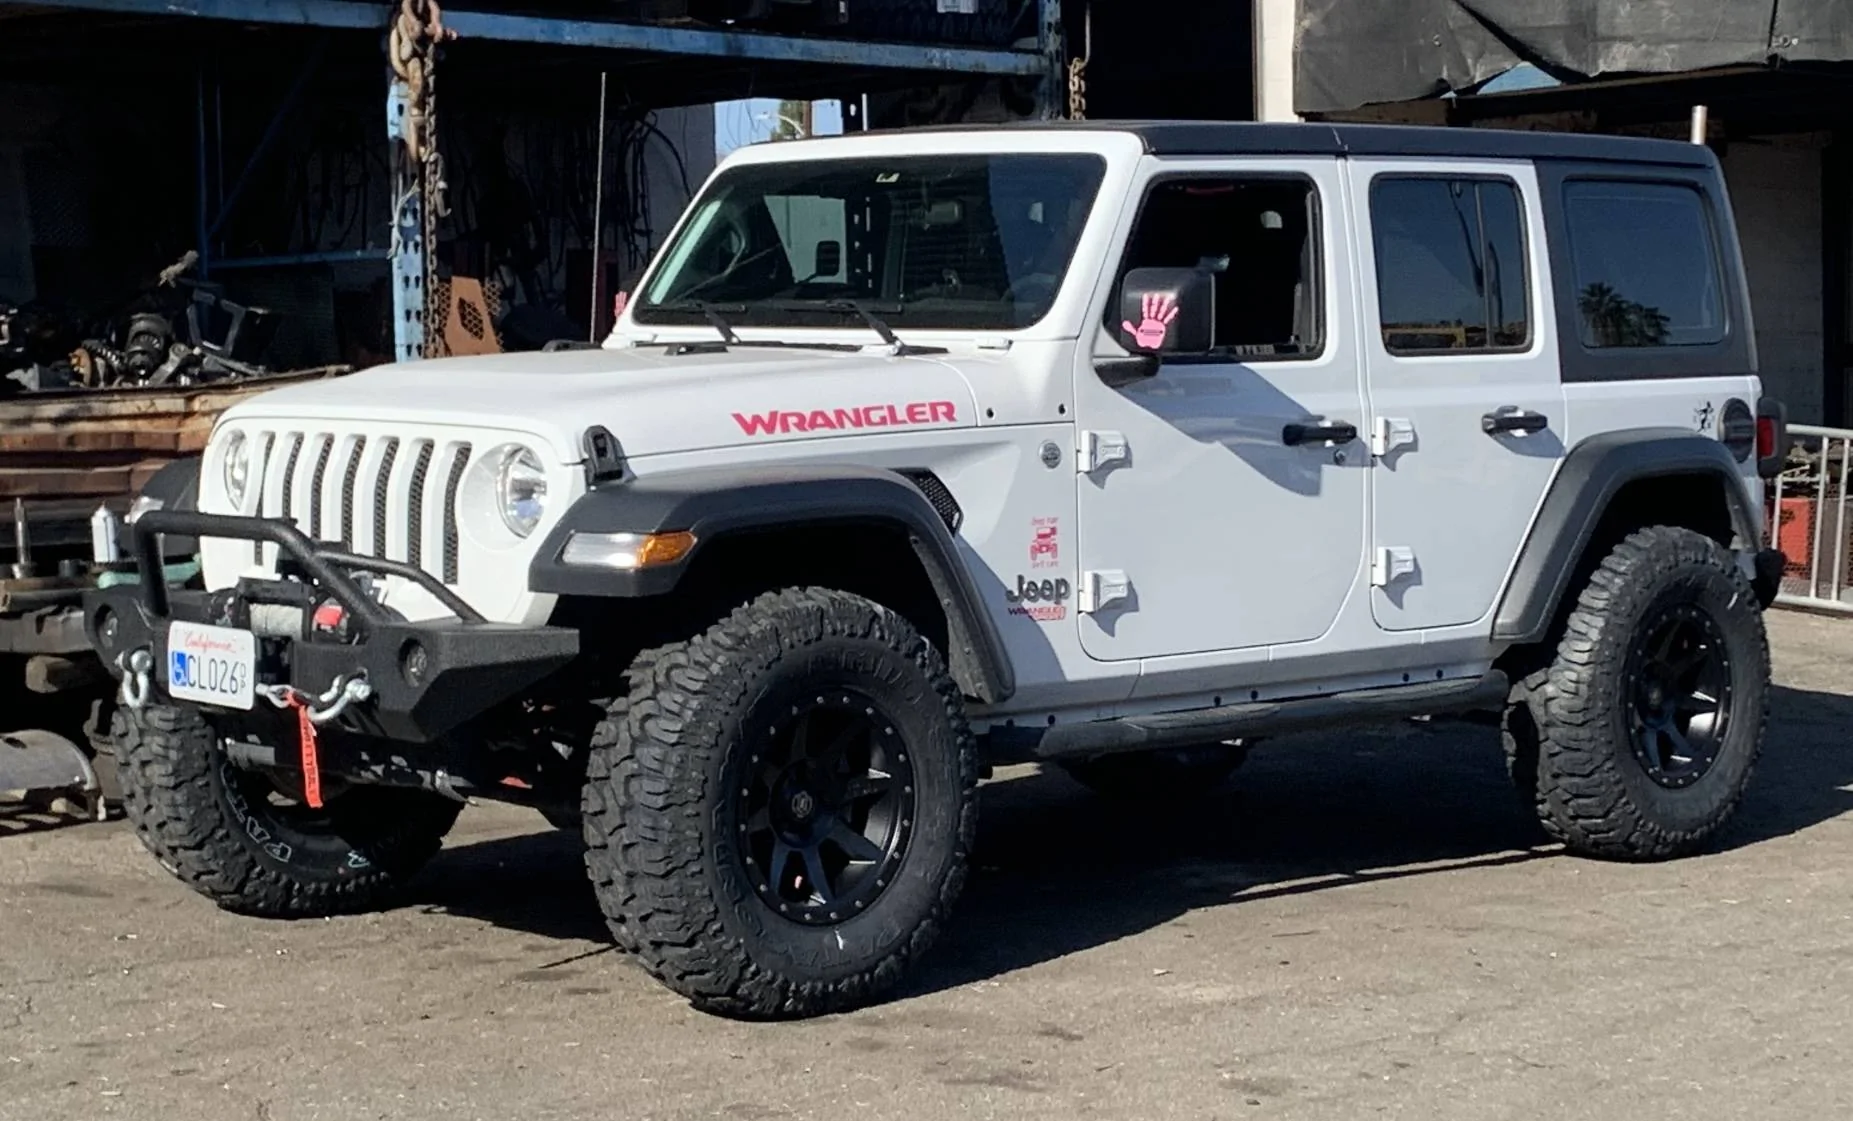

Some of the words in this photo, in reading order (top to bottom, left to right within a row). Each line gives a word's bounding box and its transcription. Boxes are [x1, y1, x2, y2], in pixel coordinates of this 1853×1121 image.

[731, 401, 958, 437] WRANGLER
[1005, 574, 1071, 605] Jeep
[187, 654, 240, 695] CL026
